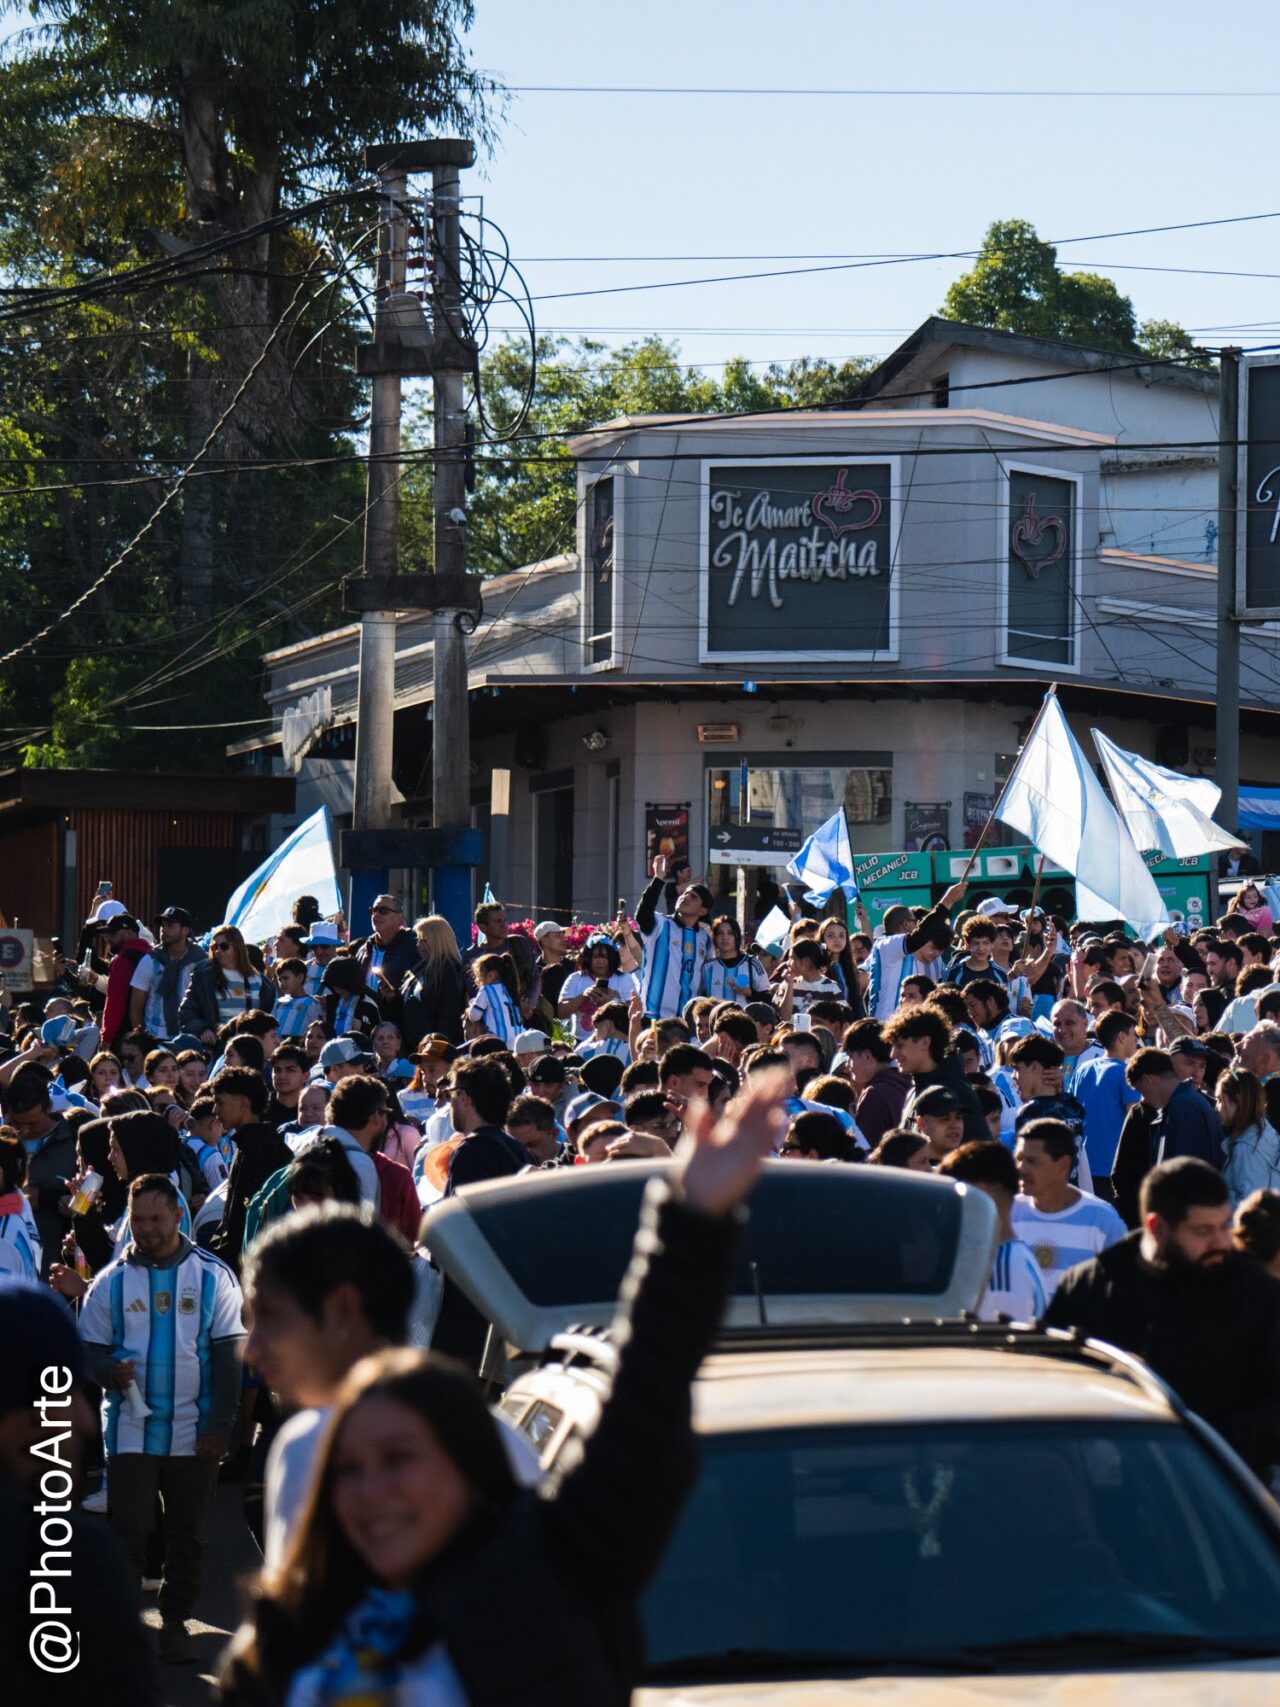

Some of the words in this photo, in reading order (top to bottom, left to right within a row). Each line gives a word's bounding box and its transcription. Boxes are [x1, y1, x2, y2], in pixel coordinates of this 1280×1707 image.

[711, 490, 743, 529] Te
[745, 491, 813, 531] Amaré
[713, 526, 881, 608] Maitena
[773, 839, 784, 847] 100
[788, 840, 800, 848] 200
[855, 855, 879, 875] XILIO
[863, 855, 908, 887] MECANICO
[1179, 856, 1198, 866] JCB
[898, 870, 918, 880] JCB
